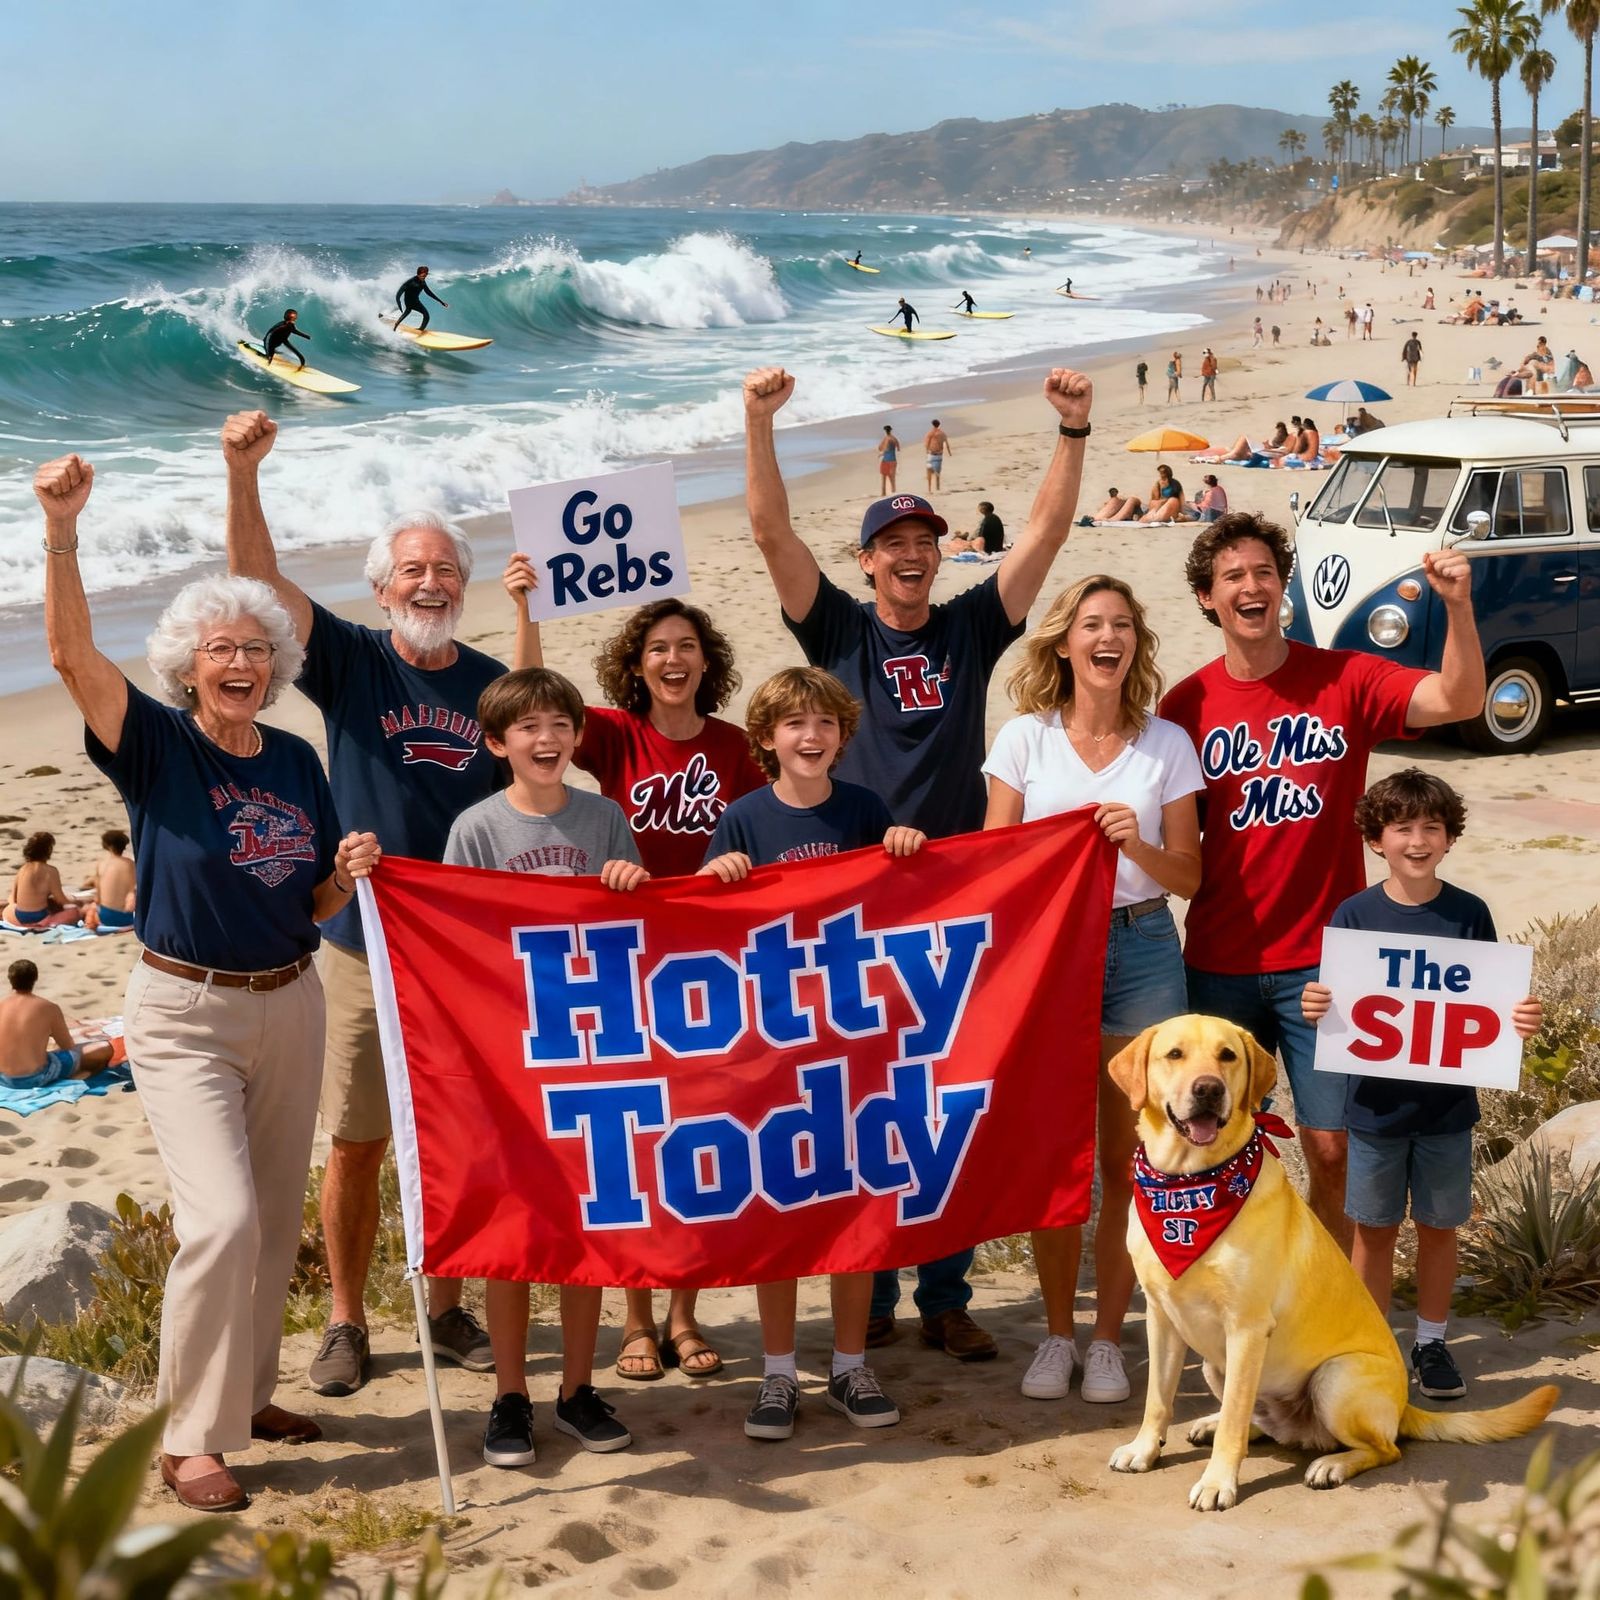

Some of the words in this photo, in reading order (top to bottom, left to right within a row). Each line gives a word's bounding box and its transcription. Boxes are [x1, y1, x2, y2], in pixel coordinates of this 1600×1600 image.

[562, 490, 633, 545] Go
[546, 543, 673, 606] Rebs
[1313, 554, 1351, 610] VW
[1202, 722, 1266, 779] Ole
[1267, 713, 1348, 769] Miss
[1230, 774, 1323, 831] Miss
[511, 903, 993, 1067] Hotty
[1379, 948, 1471, 993] The
[1347, 995, 1501, 1069] SIP
[541, 1056, 994, 1231] Toddy
